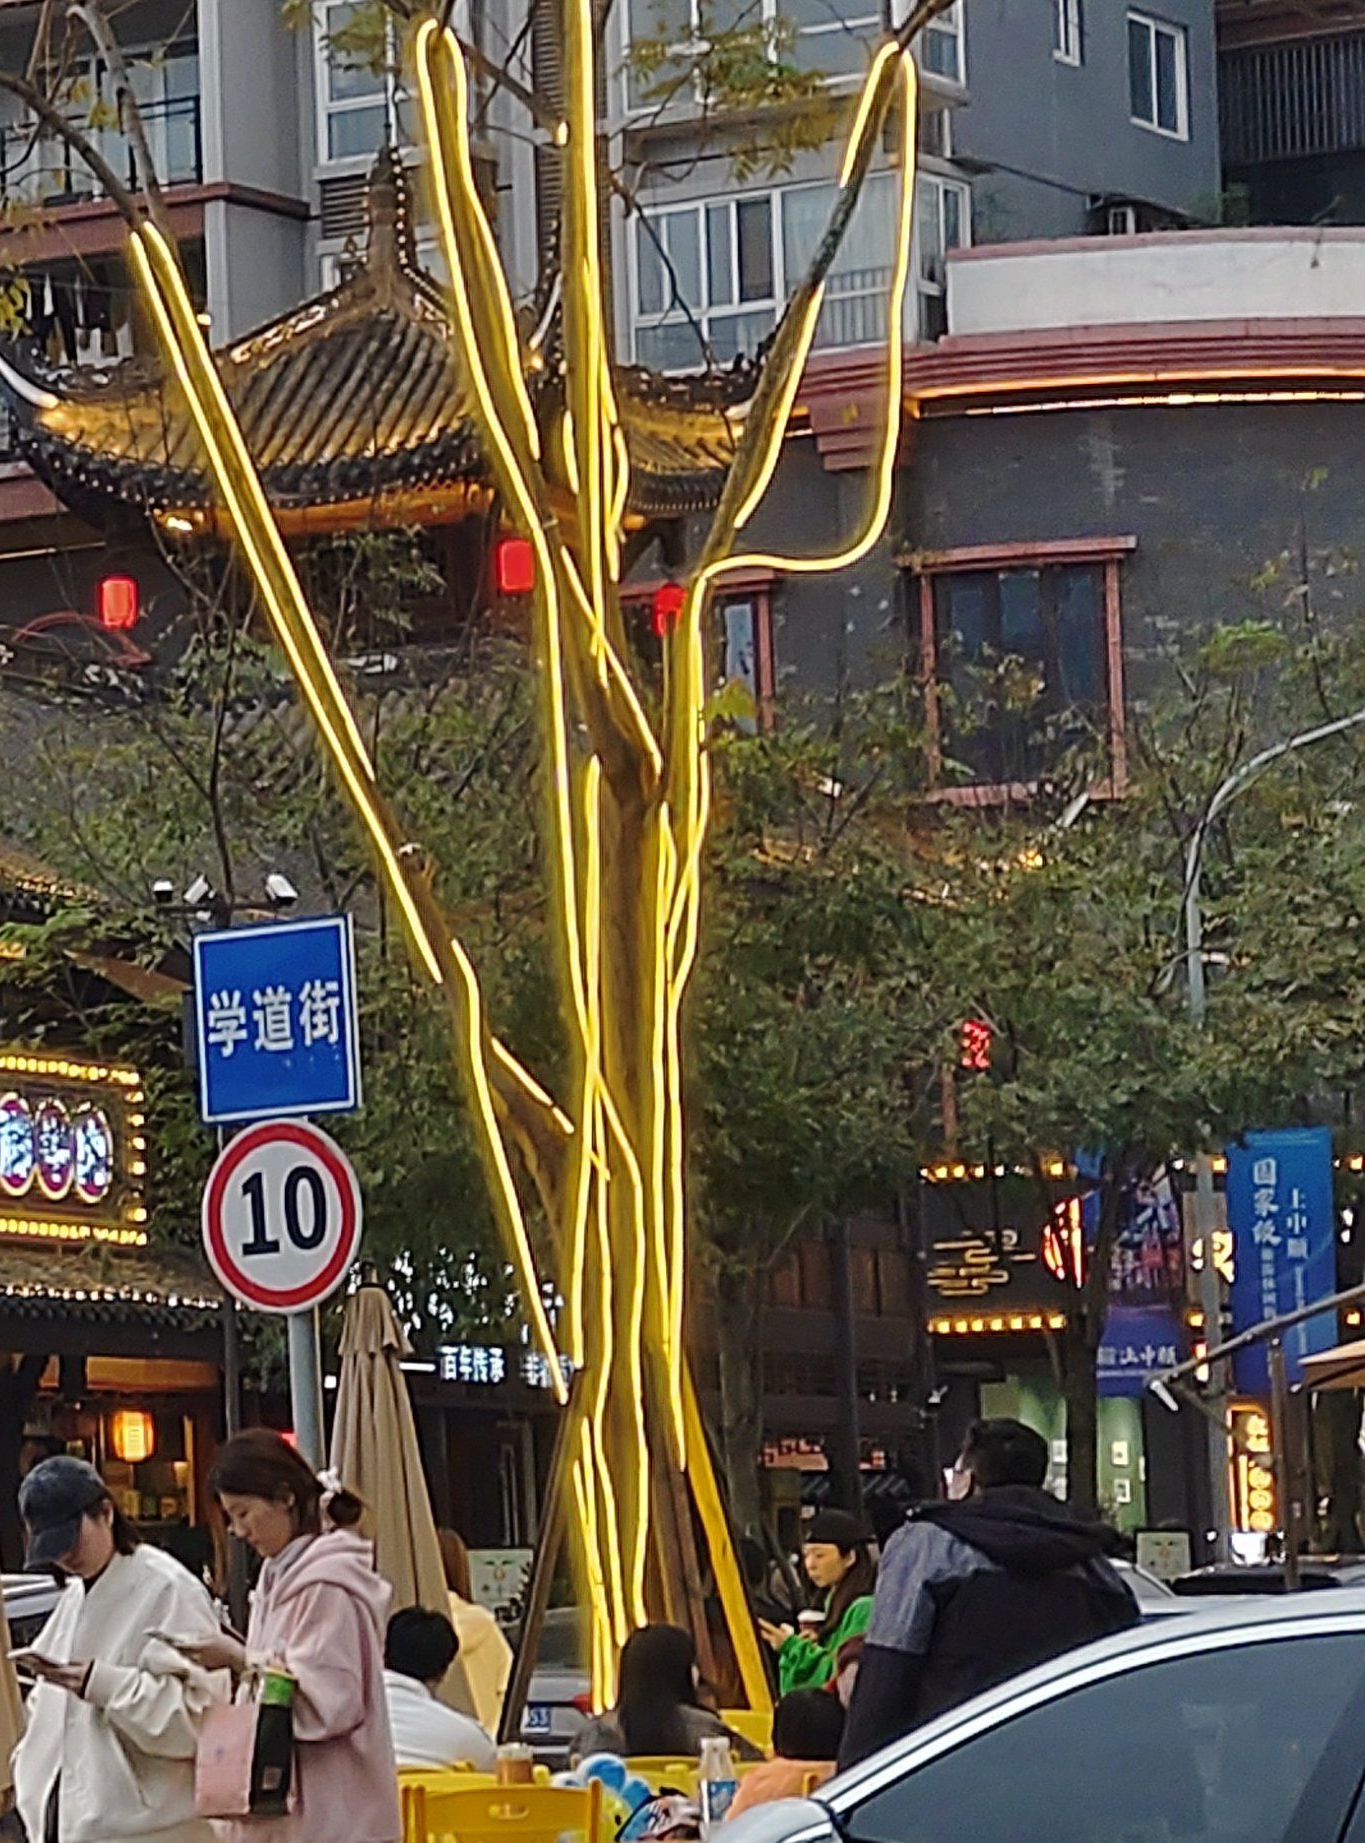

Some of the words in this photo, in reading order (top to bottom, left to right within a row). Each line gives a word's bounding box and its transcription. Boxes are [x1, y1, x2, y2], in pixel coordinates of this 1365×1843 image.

[207, 979, 340, 1058] 学道街
[241, 1165, 327, 1257] 10
